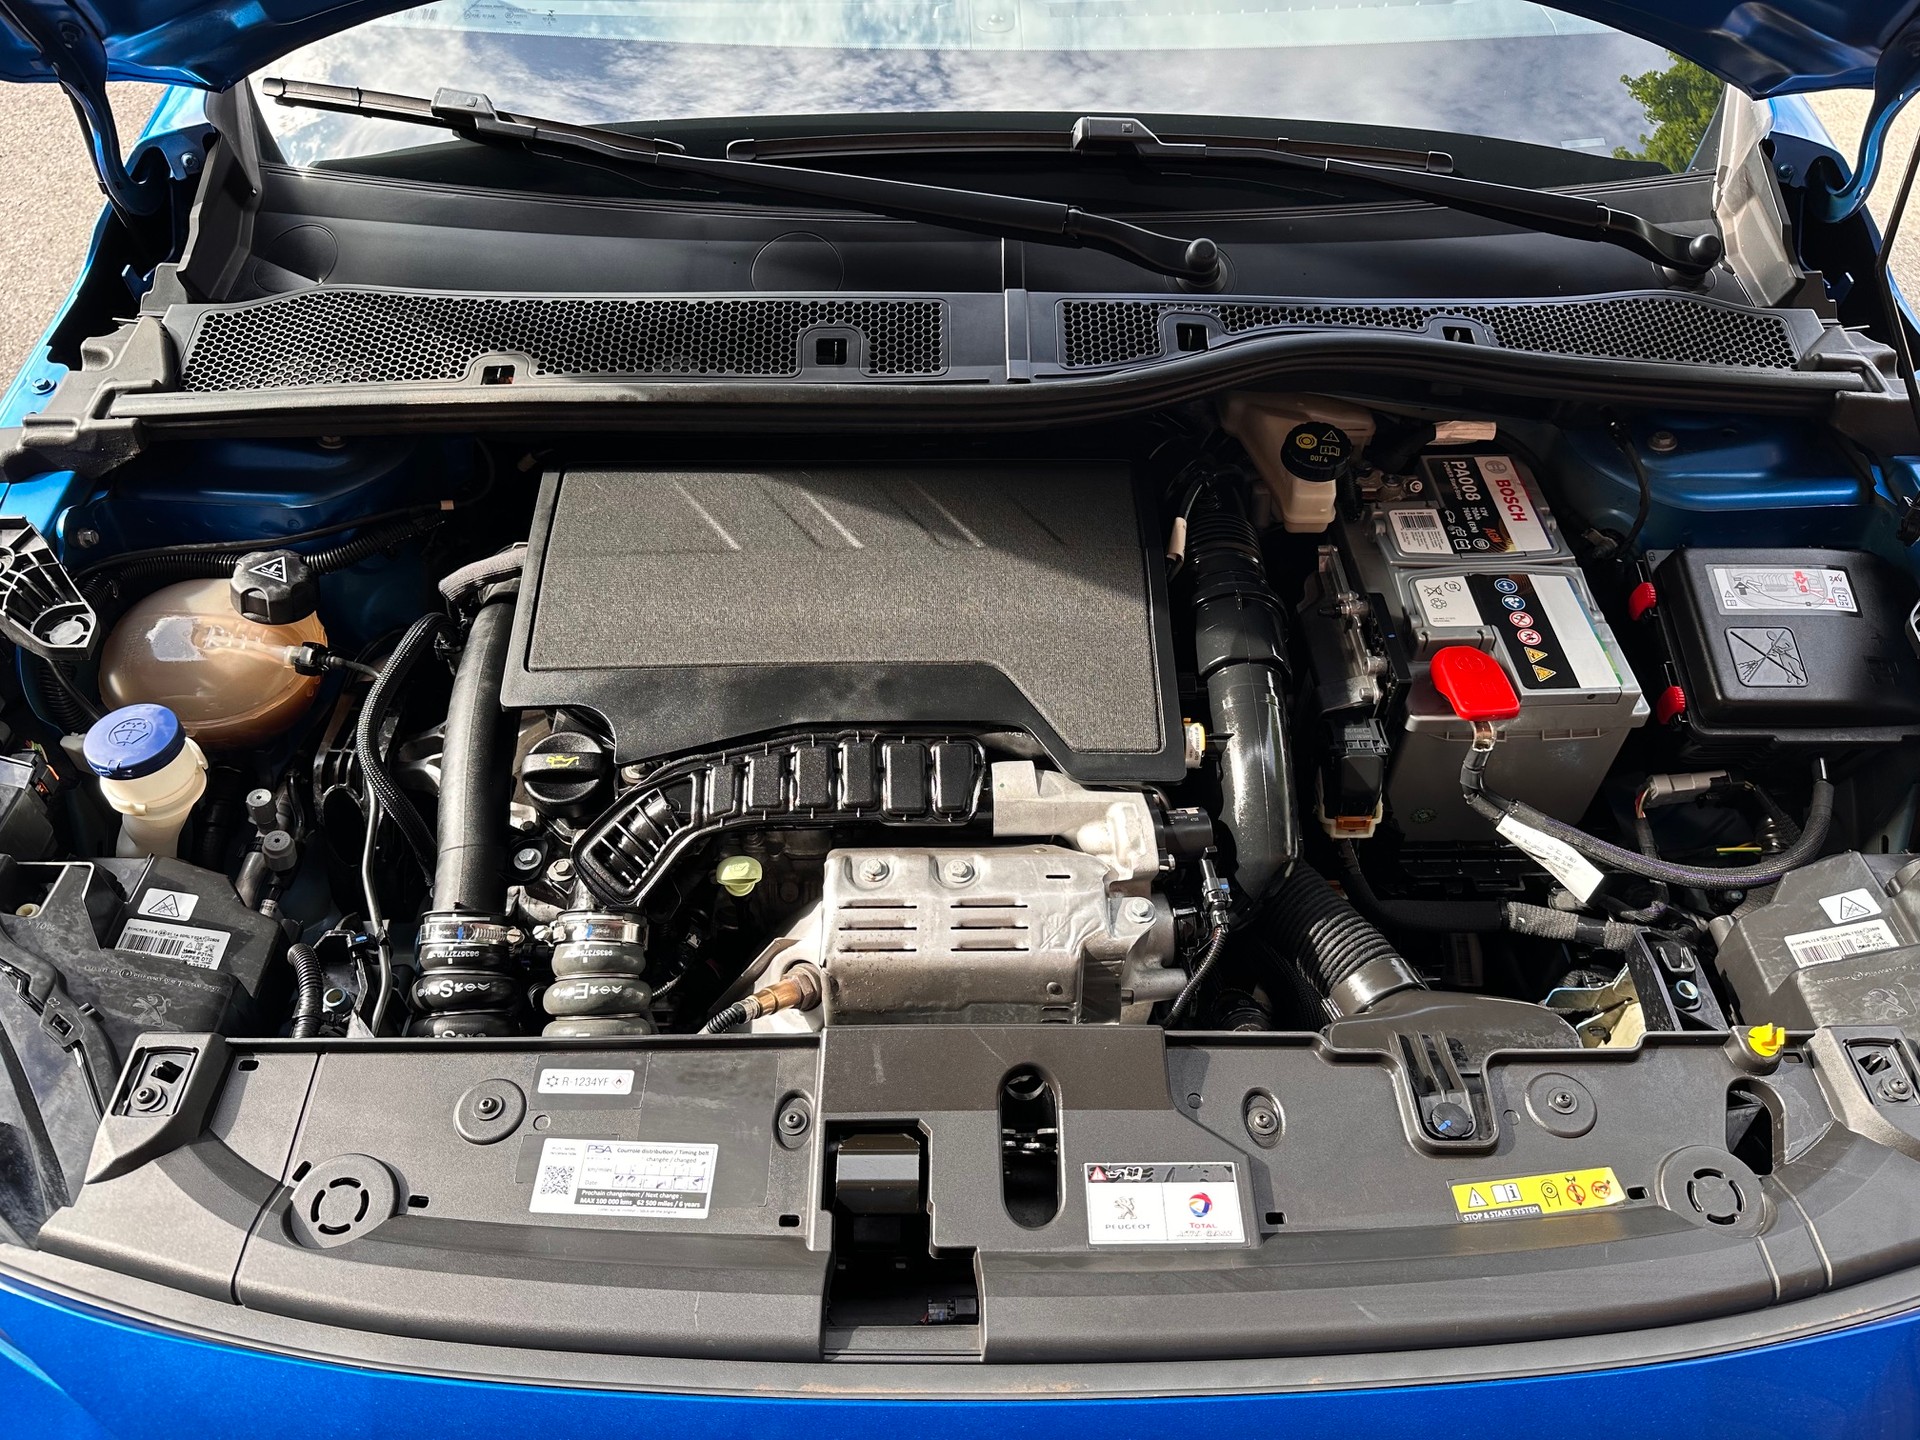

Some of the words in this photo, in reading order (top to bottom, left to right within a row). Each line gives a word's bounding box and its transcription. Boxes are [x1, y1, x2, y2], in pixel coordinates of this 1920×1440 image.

[1450, 460, 1481, 502] PA008
[1495, 480, 1528, 522] BOSCH
[1480, 506, 1489, 517] 12V
[1482, 528, 1502, 544] AGM
[440, 980, 454, 998] S
[574, 983, 590, 1000] E
[562, 1077, 609, 1087] R-1234YF
[587, 1144, 613, 1154] PSA
[1463, 1213, 1483, 1221] STOP
[1490, 1209, 1512, 1218] START
[1512, 1206, 1539, 1215] SYSTEM
